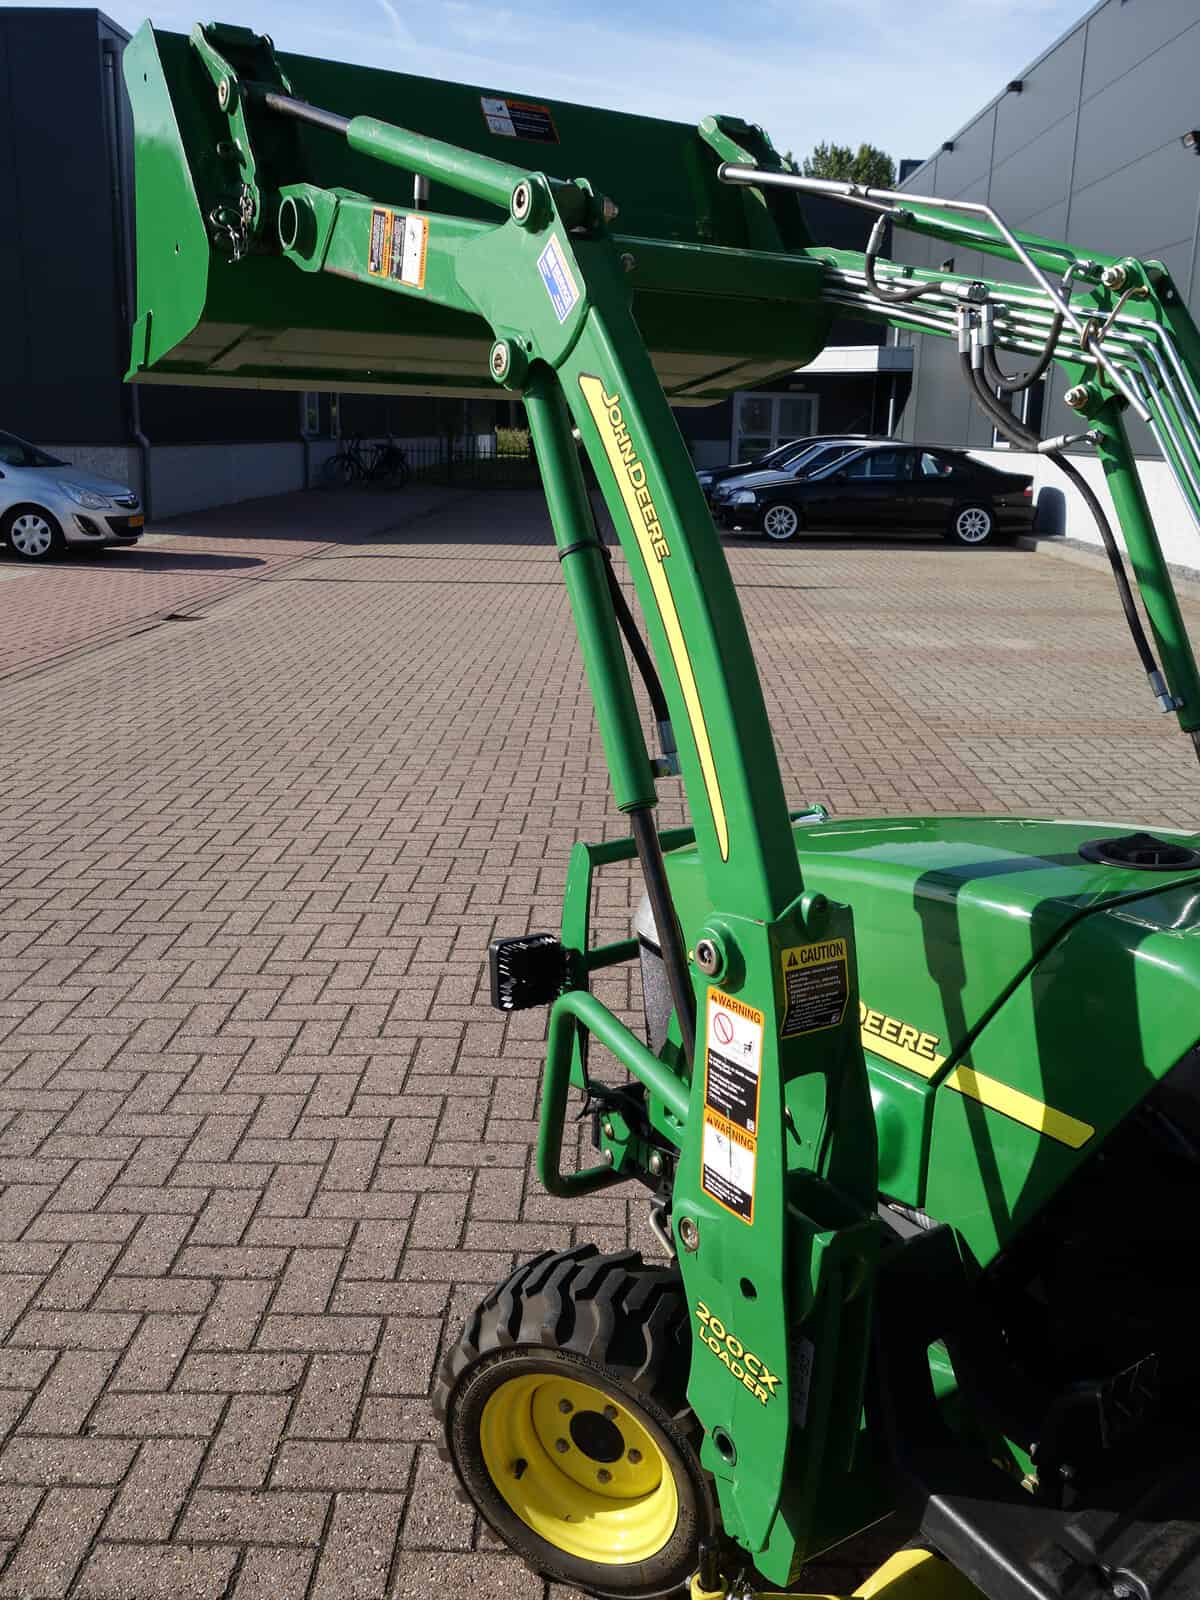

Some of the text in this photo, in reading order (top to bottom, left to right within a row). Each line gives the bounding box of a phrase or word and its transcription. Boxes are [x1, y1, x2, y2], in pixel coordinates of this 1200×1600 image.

[601, 390, 671, 561] JOHN DEERE
[800, 943, 843, 964] CAUTION
[718, 994, 761, 1024] WARNING
[695, 1301, 780, 1397] 200CX
[699, 1325, 768, 1406] LOADER
